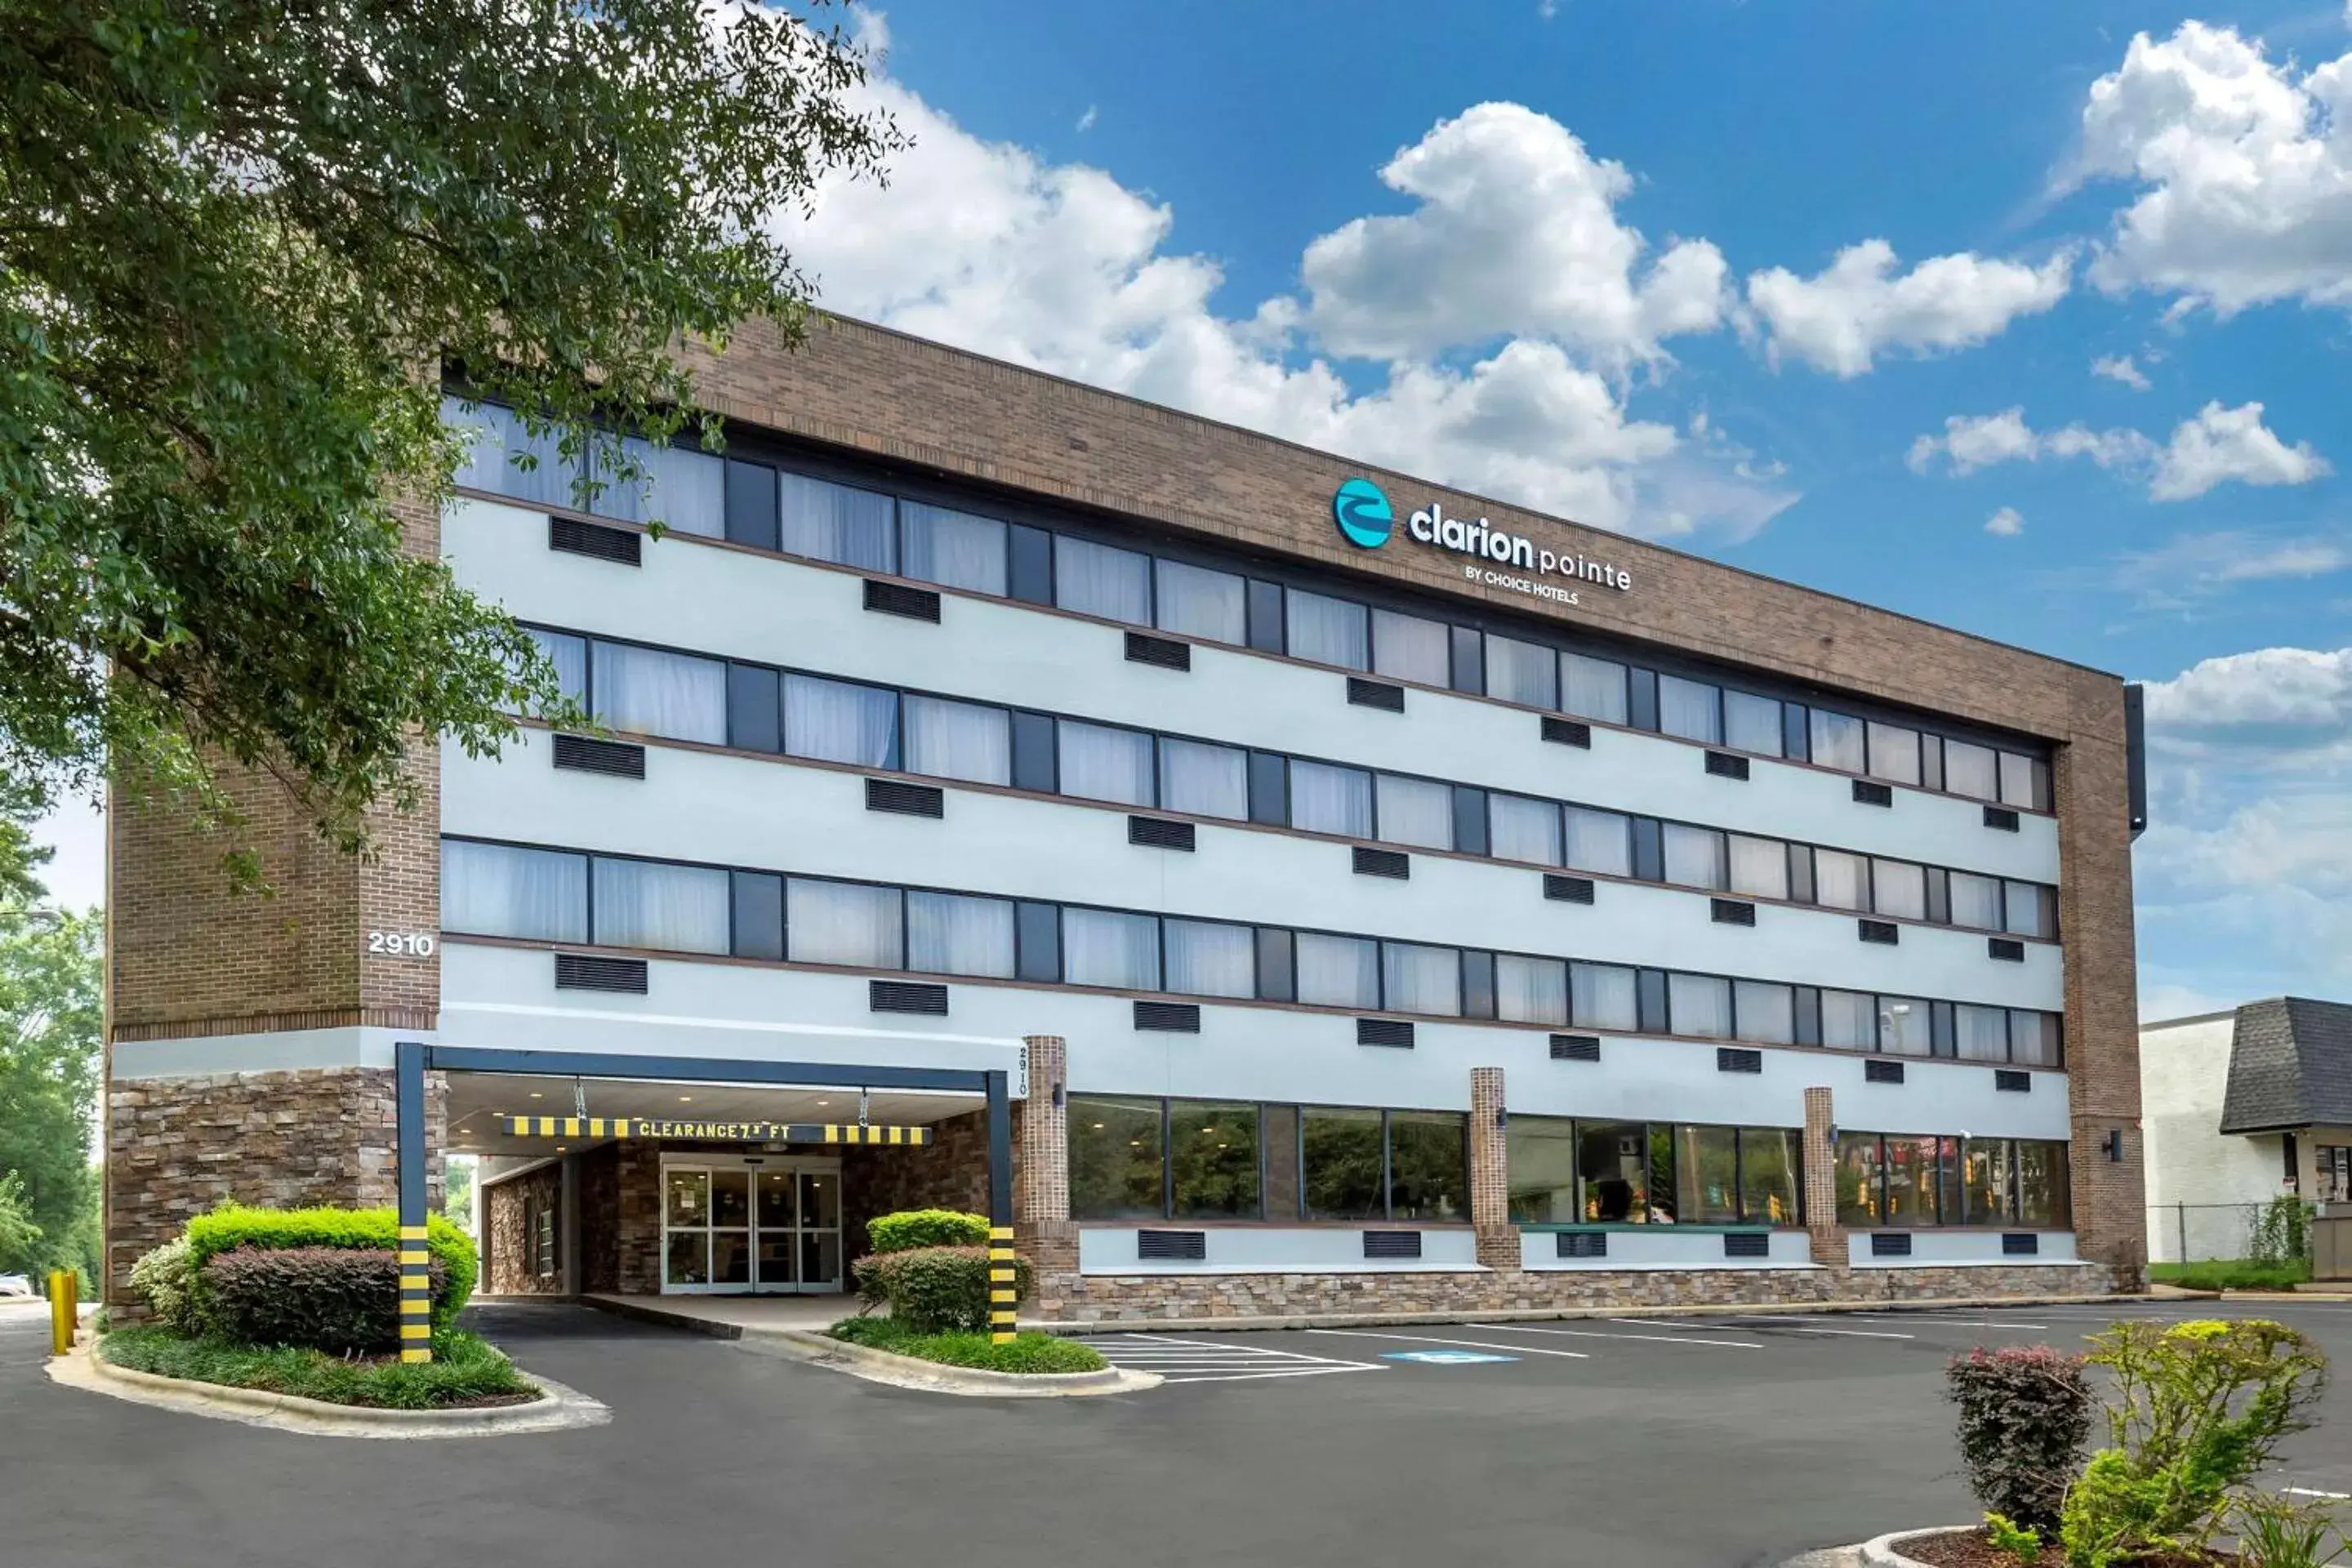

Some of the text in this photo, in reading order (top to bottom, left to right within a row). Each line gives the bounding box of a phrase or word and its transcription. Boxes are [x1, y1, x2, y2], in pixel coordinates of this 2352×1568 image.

[1410, 502, 1632, 590] clarion pointe
[1465, 565, 1579, 605] BY CHOICE HOTELS
[368, 932, 434, 957] 2910
[1018, 1046, 1027, 1095] 2910
[639, 1122, 737, 1138] CLEARANCE
[769, 1125, 791, 1140] FT
